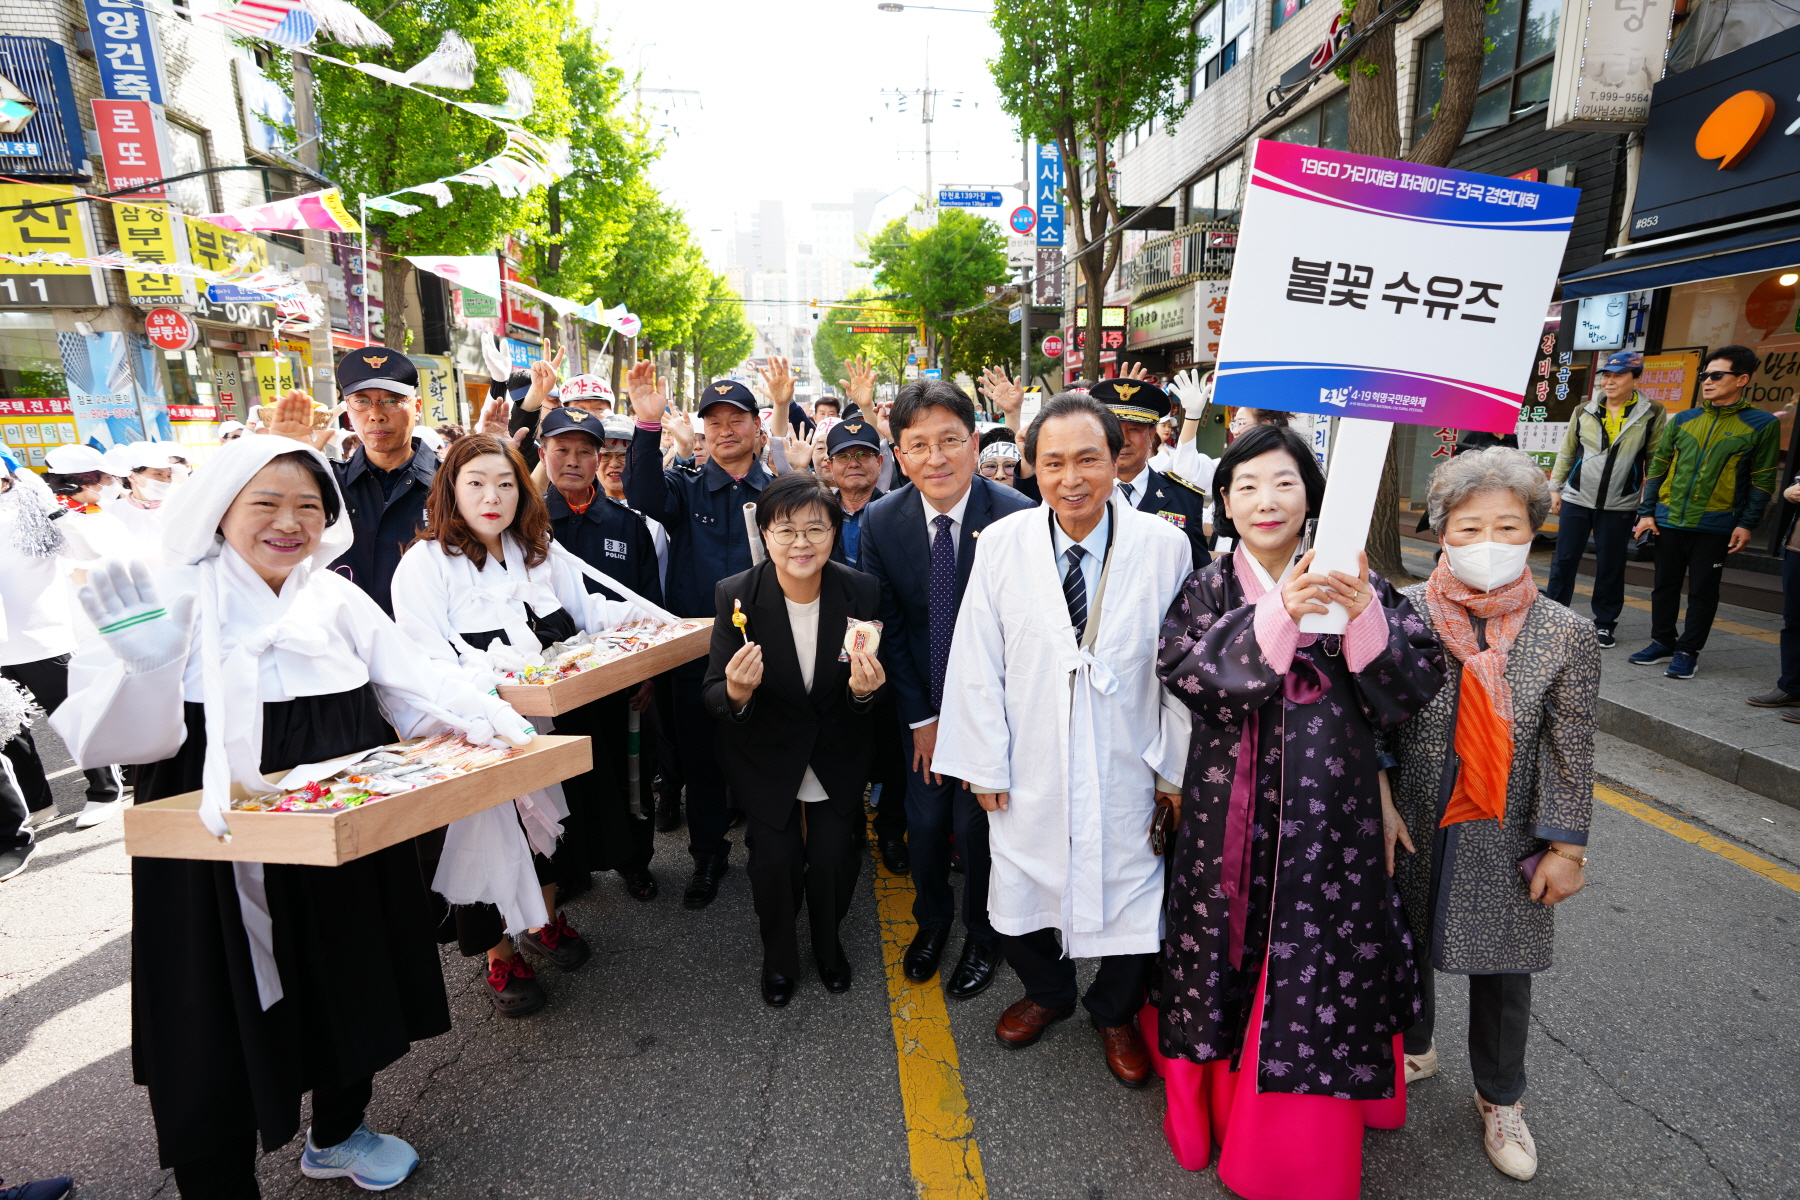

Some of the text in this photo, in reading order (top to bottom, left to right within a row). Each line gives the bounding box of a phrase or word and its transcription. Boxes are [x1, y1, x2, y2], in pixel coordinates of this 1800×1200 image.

[97, 0, 151, 101] 양건축
[1590, 91, 1649, 103] T.999-9564
[112, 109, 146, 166] 로또
[1300, 157, 1540, 210] 1960 거리재현 퍼레이드 전국 경연대회
[120, 206, 164, 223] 삼성
[1635, 215, 1658, 229] #853
[1286, 257, 1503, 323] 불꽃 수유즈
[132, 295, 184, 305] 904-0011
[153, 314, 177, 325] 삼성
[197, 296, 270, 327] 4-0011
[148, 326, 187, 341] 부동산
[1536, 333, 1555, 401] 갈비탕
[262, 376, 292, 390] 삼성
[1372, 392, 1427, 408] 혁명국민문화제
[1744, 383, 1795, 403] rban
[1519, 406, 1547, 422] 전문
[605, 552, 626, 560] POLICE
